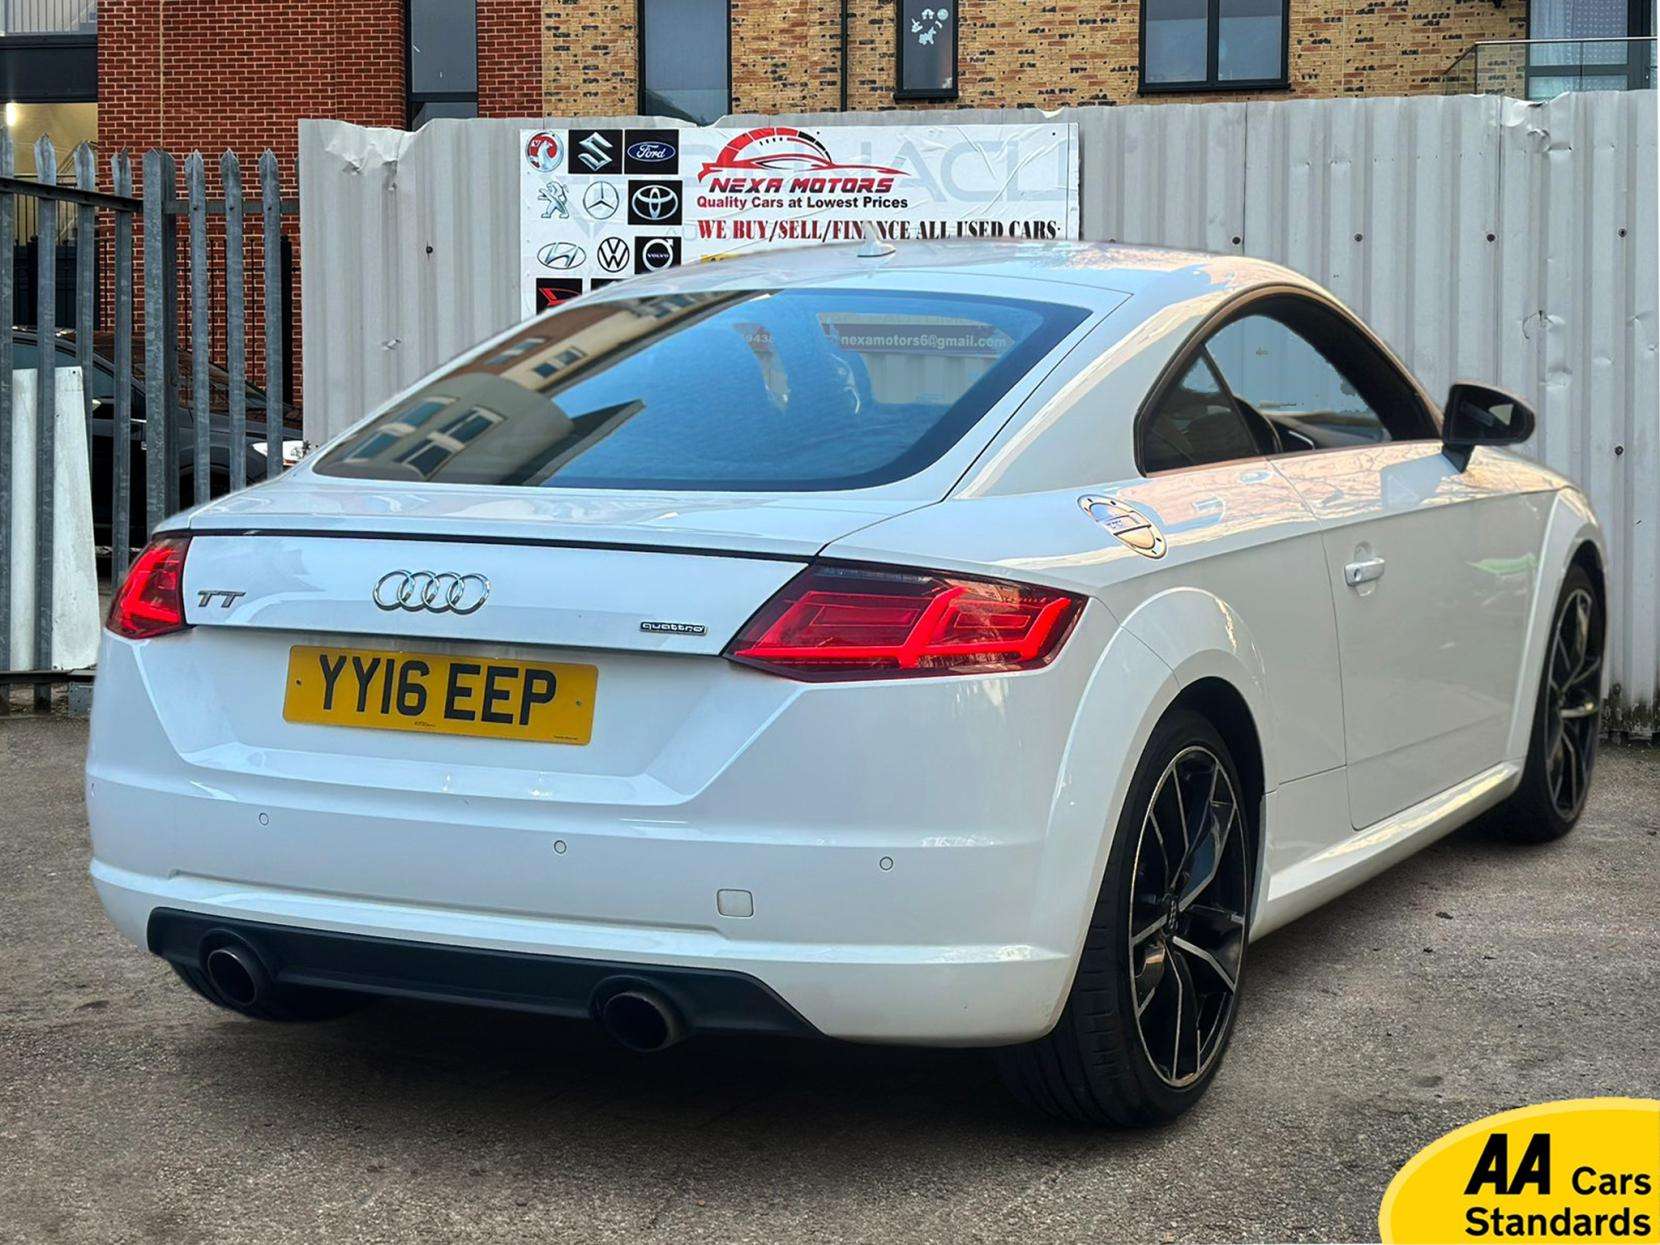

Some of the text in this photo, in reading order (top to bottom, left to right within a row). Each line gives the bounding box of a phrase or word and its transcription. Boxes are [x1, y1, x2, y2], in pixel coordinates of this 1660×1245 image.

[636, 144, 666, 159] Ford
[708, 177, 894, 194] NEXA MOTORS
[697, 196, 908, 209] Quality Cars at Lowest Prices
[697, 219, 727, 240] WE
[732, 219, 911, 243] BUY/SELL/FINNCE
[917, 220, 949, 240] ALL
[956, 220, 1004, 238] USED
[198, 590, 246, 608] TT
[642, 623, 703, 632] quattro
[318, 653, 558, 726] YY16 EEP
